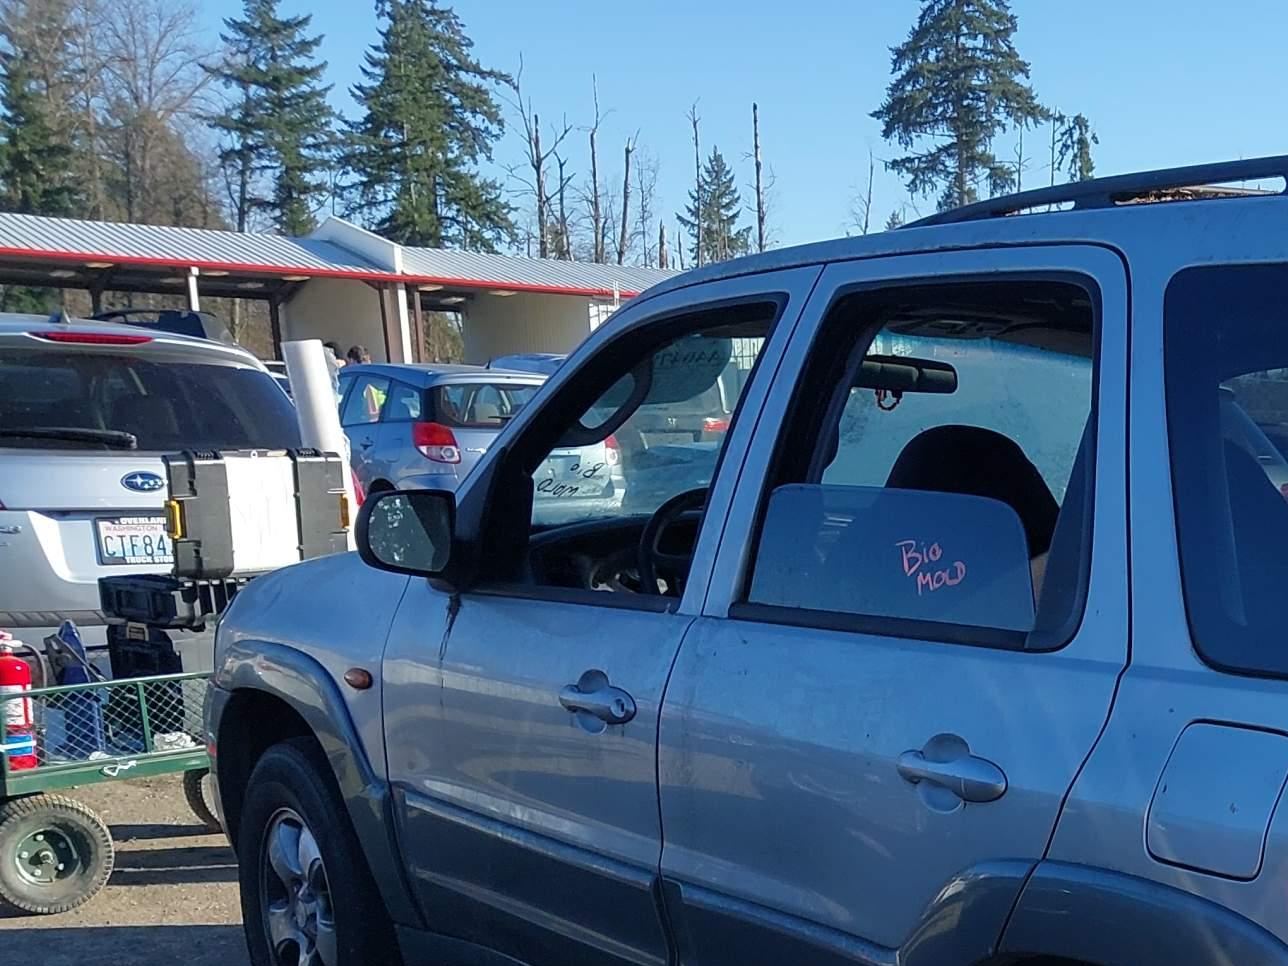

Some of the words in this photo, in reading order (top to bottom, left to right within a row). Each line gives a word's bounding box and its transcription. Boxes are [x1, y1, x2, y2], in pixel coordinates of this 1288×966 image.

[125, 556, 152, 564] TRUCK
[896, 540, 942, 576] Bio
[917, 561, 966, 596] MOLD
